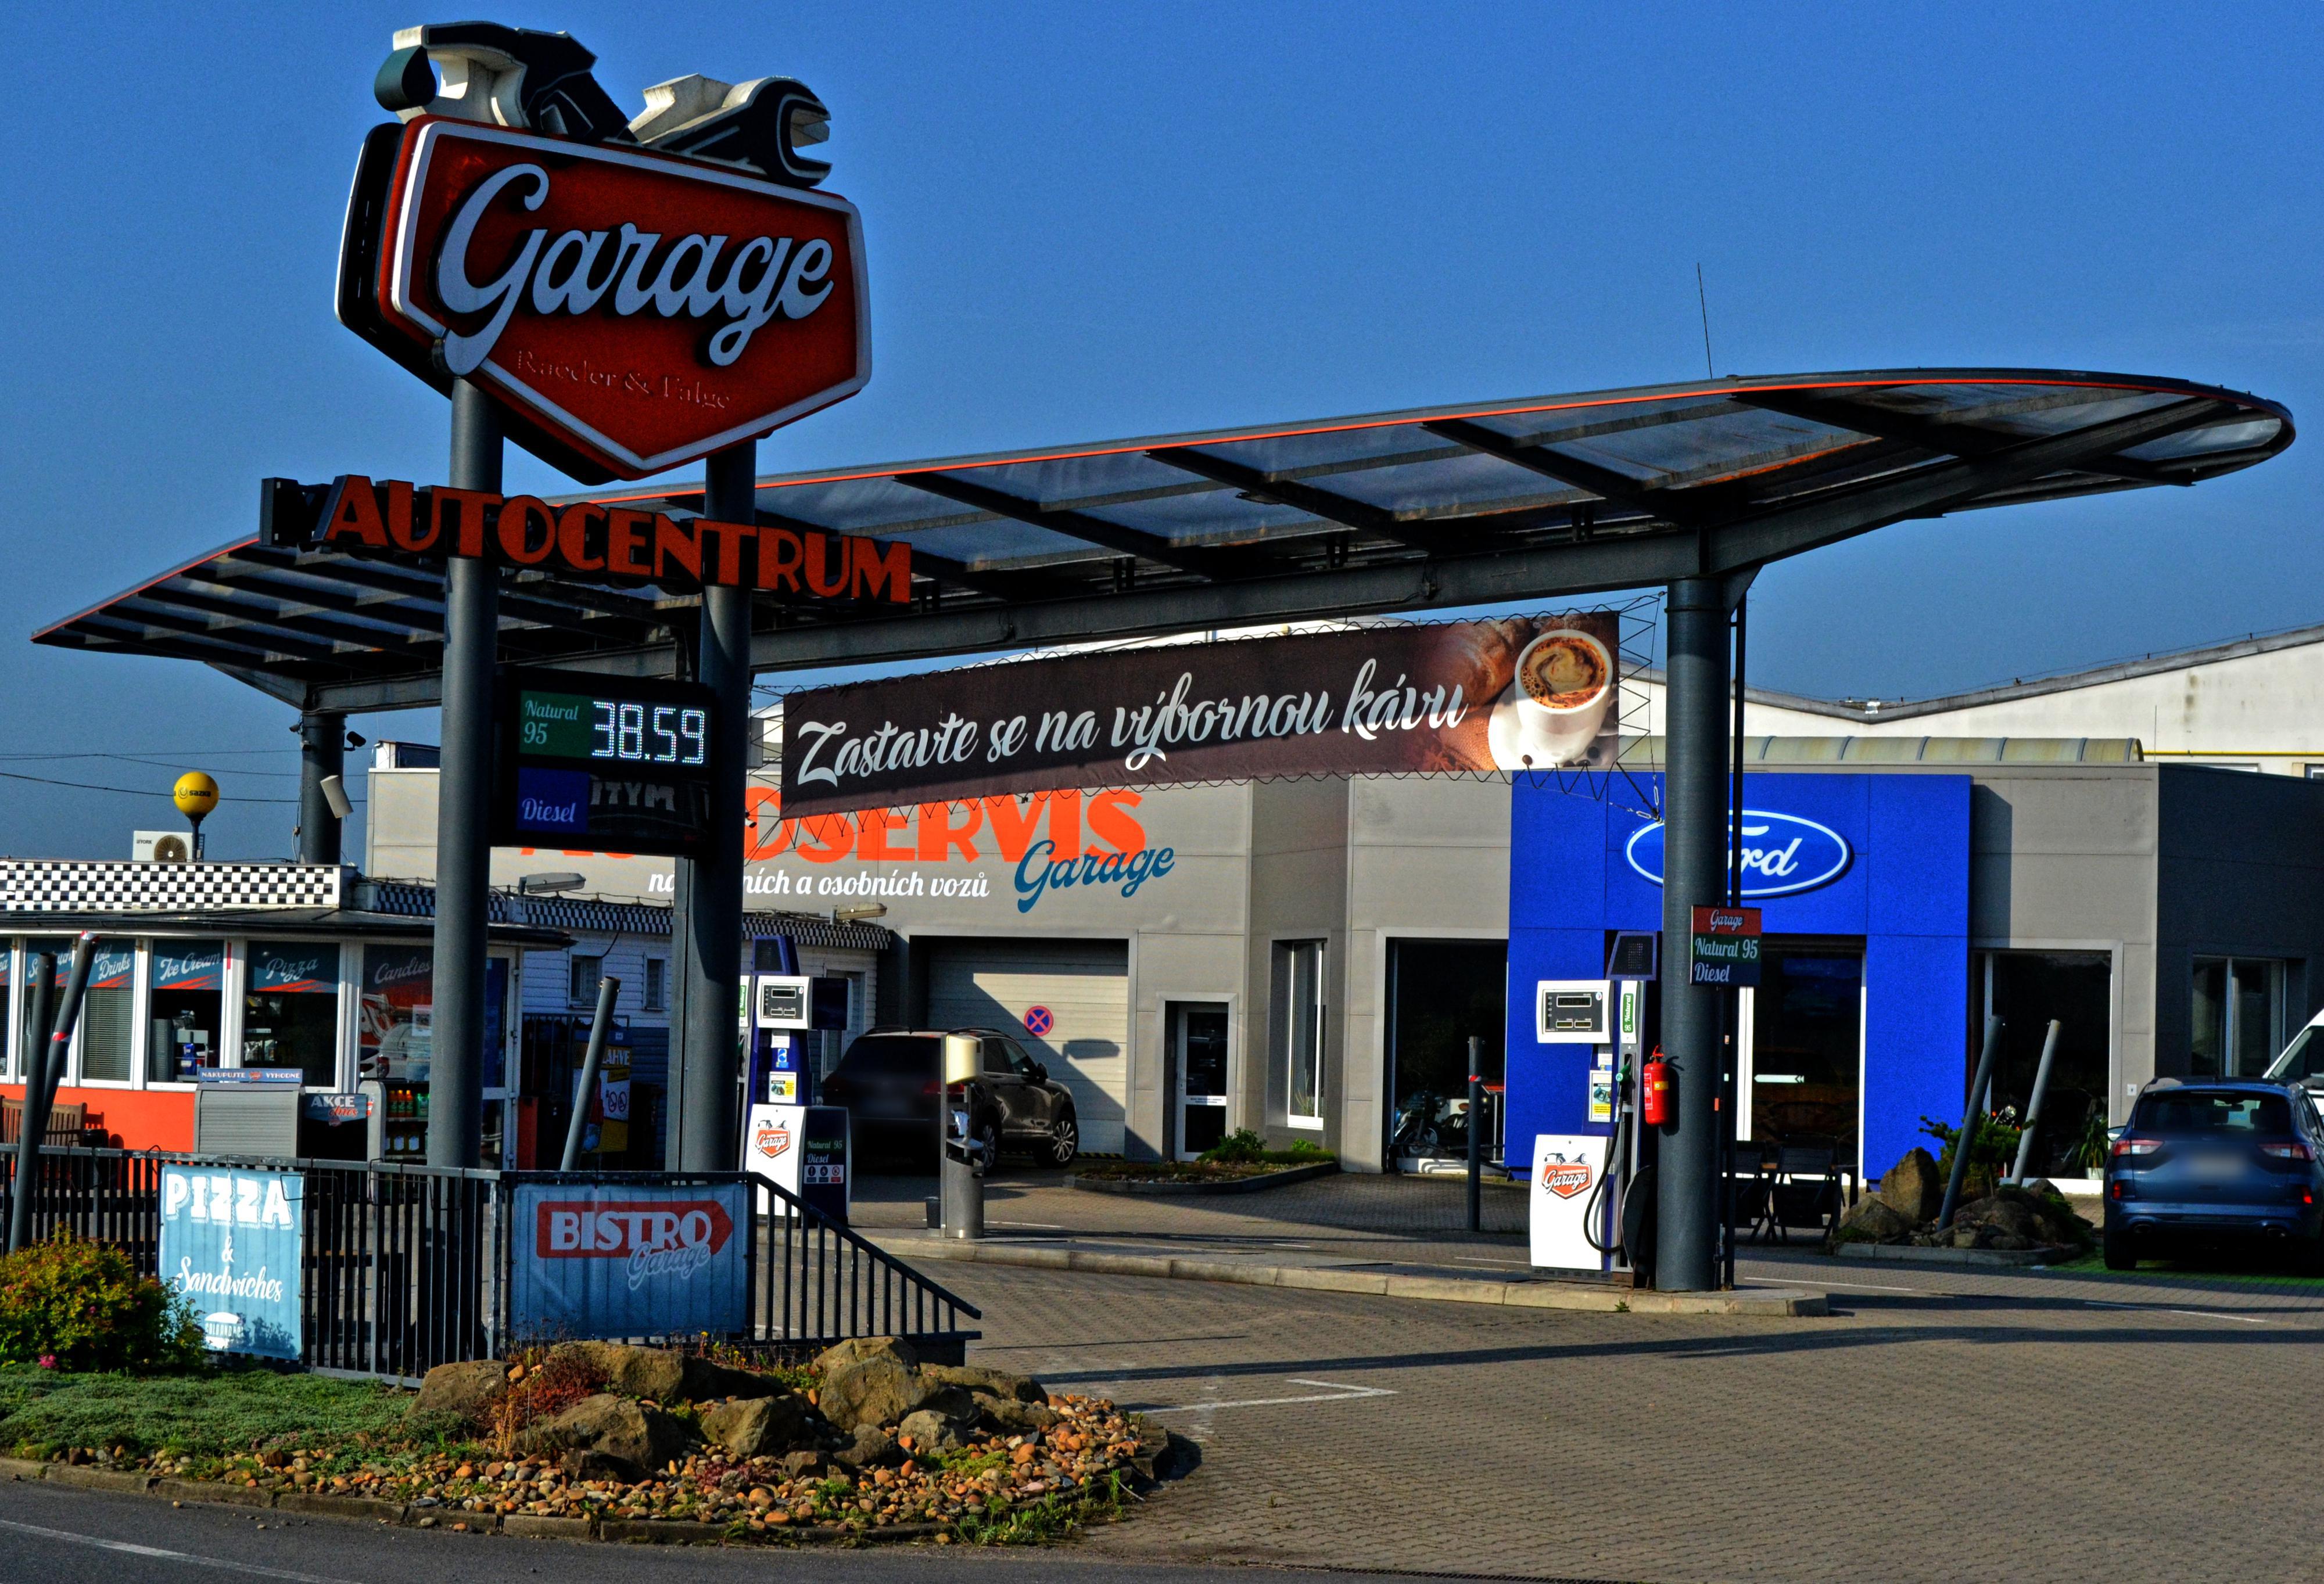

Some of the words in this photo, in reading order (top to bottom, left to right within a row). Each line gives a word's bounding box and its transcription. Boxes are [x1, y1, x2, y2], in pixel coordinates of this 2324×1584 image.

[438, 163, 834, 376] Garage
[318, 475, 912, 604] AUTOCENTRUM
[525, 700, 579, 721] Natural
[798, 713, 978, 787] Zastavte
[988, 716, 1027, 763] se
[1035, 710, 1101, 753] na
[1110, 671, 1334, 771] výbornou
[1341, 658, 1469, 741] kávu
[523, 721, 549, 745] 95
[591, 700, 705, 765] 38.59
[522, 798, 576, 823] Diesel
[796, 877, 813, 895] a
[819, 868, 924, 896] osobních
[930, 872, 989, 897] vozů
[1014, 839, 1175, 913] Garage
[1710, 909, 1744, 932] Garage
[1695, 937, 1740, 958] Natural
[1742, 939, 1759, 959] 95
[98, 952, 132, 981] Drinks
[159, 959, 180, 981] Ice
[181, 951, 223, 975] Cream
[266, 957, 320, 983] Pizza
[374, 956, 432, 985] Candies
[1694, 962, 1731, 983] Diesel
[311, 1095, 356, 1108] AKCE
[755, 1133, 787, 1154] Garage
[807, 1140, 831, 1150] Natural
[833, 1139, 843, 1150] 95
[806, 1153, 830, 1164] Diesel
[1543, 1169, 1588, 1195] Garage
[166, 1173, 294, 1230] PIZZA
[550, 1210, 712, 1251] BISTRO
[221, 1235, 235, 1263] &
[174, 1255, 284, 1303] Sandwiches
[626, 1241, 711, 1291] Garage
